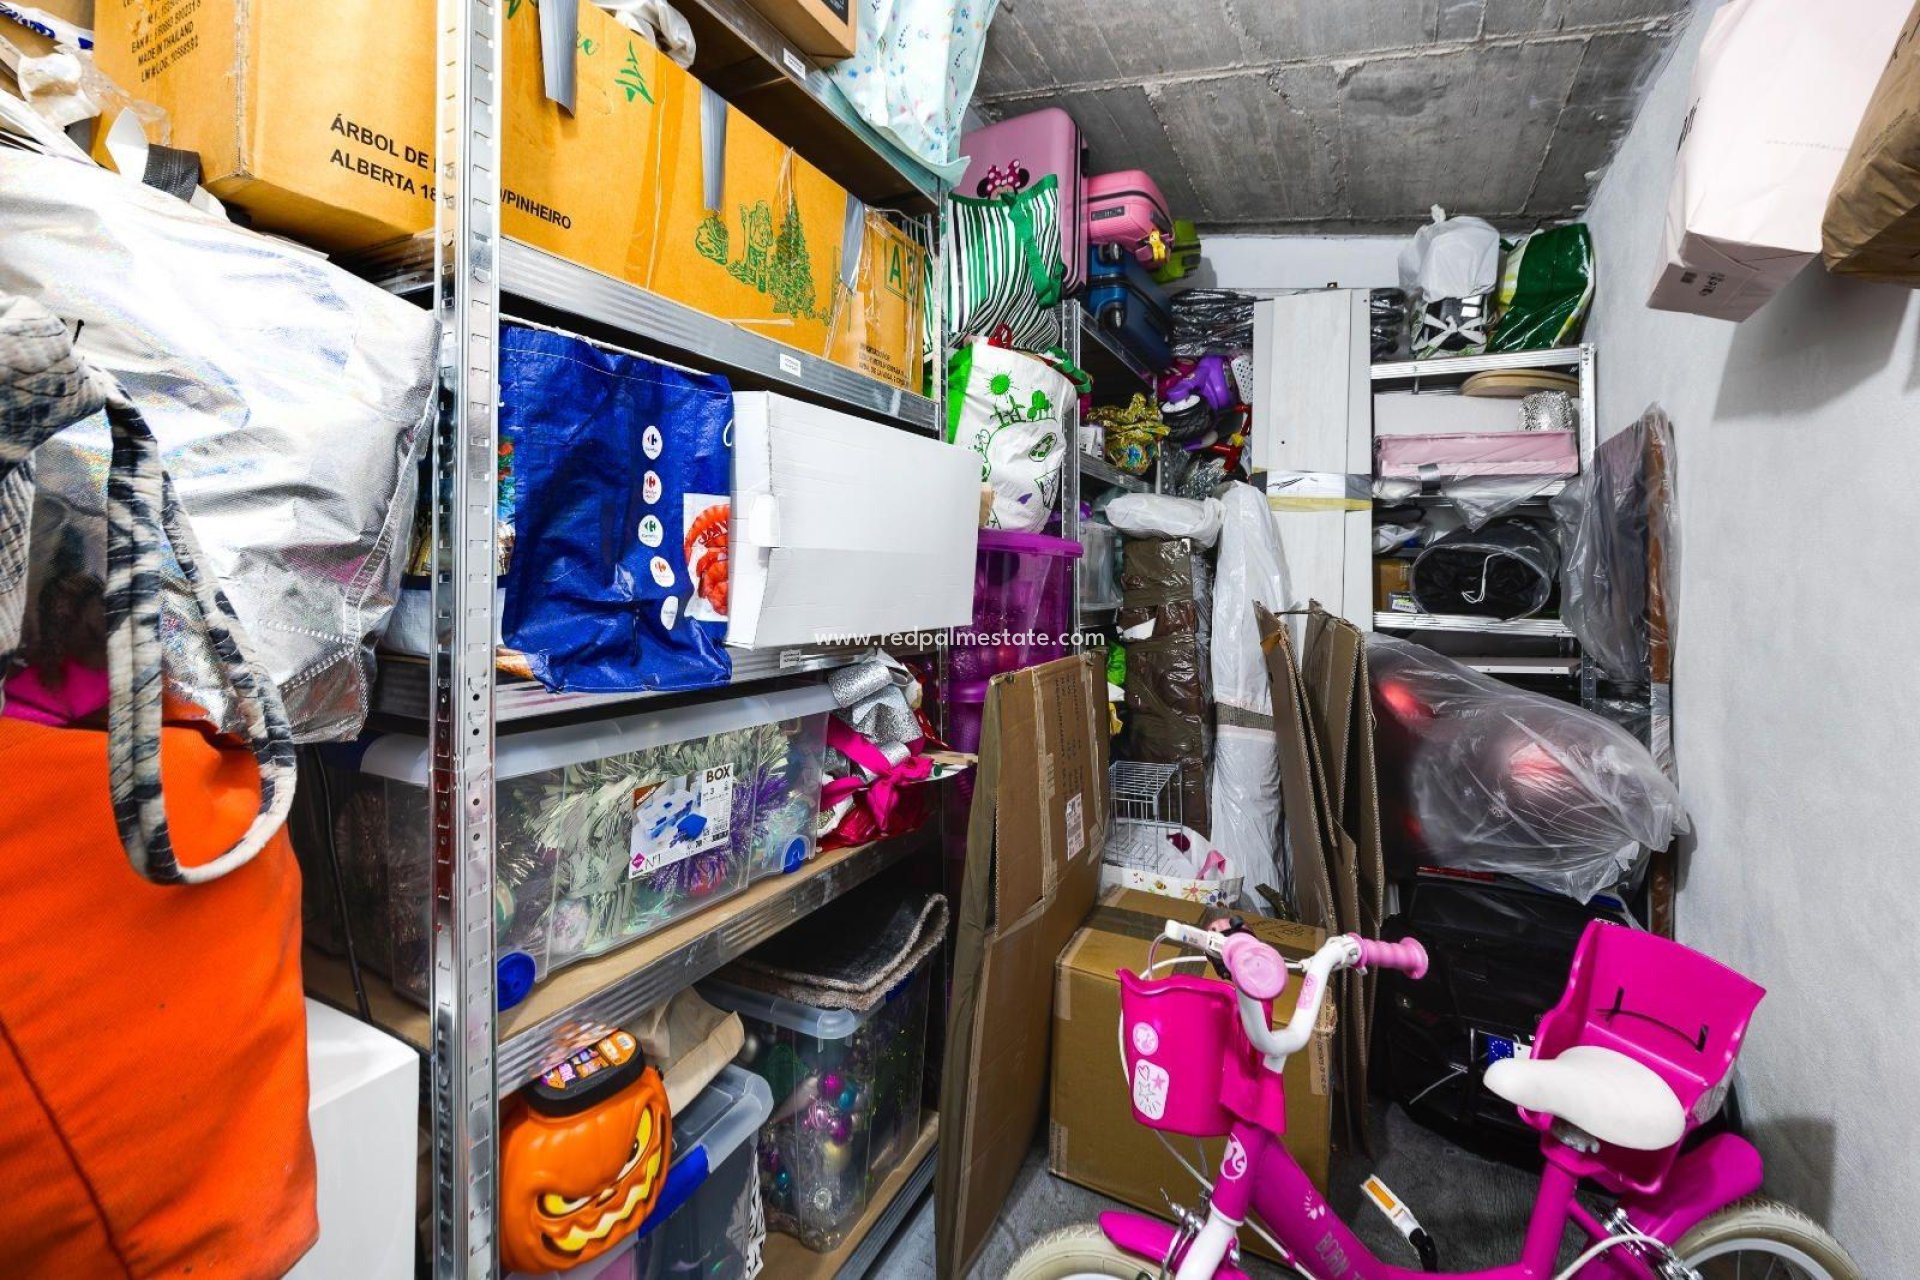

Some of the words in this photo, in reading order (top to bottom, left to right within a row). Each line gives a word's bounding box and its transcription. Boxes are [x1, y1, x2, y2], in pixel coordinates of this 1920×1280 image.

[138, 48, 155, 66] MADE
[163, 21, 194, 50] THAILAND
[330, 113, 399, 158] ÁRBOL
[404, 145, 429, 170] DE
[330, 148, 415, 195] ALBERTA
[500, 188, 571, 230] /PINHEIRO
[706, 765, 731, 784] BOX
